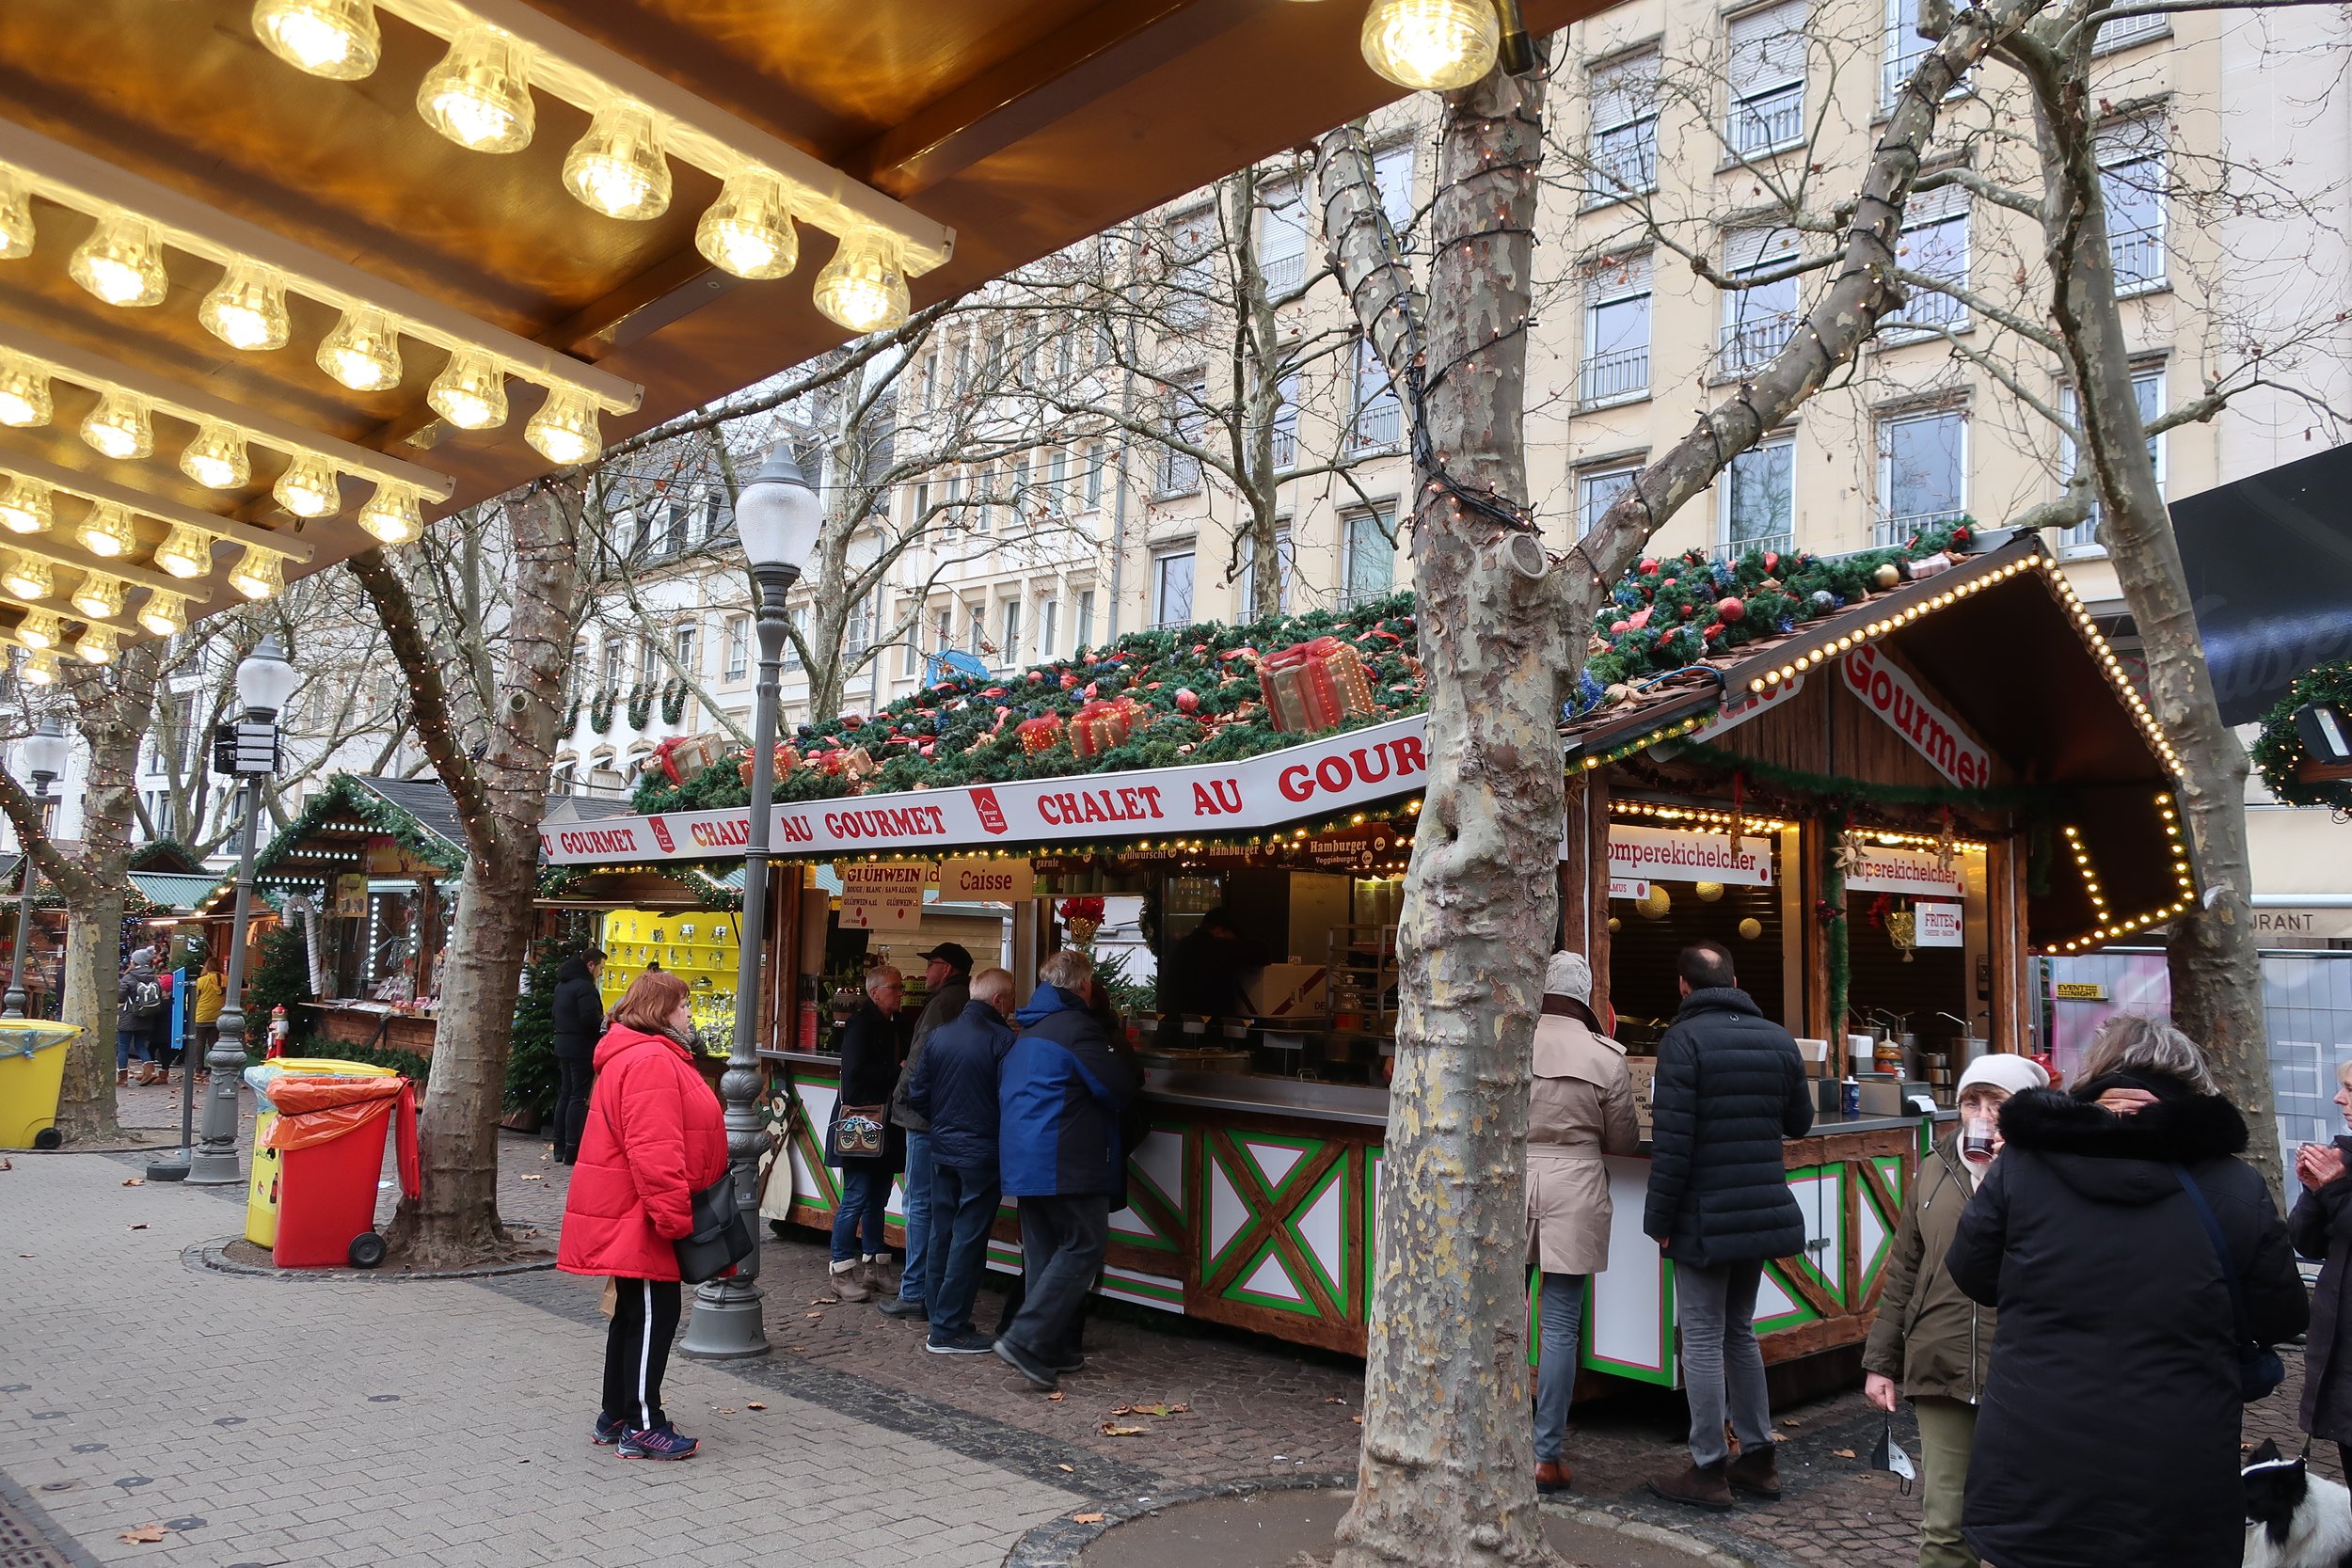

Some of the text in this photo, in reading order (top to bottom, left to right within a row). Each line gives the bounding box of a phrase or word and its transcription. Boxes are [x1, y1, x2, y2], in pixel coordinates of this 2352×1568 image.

[1845, 642, 1988, 789] Gourmet
[541, 834, 553, 856] U
[560, 829, 638, 854] GOURMET
[691, 819, 751, 847] CHALE
[781, 815, 815, 843] AU
[824, 805, 946, 839] GOURMET
[1037, 784, 1165, 826] CHALET
[1191, 778, 1244, 816] AU
[1278, 736, 1426, 802] GOUR
[1209, 844, 1259, 858] Hamburger
[1310, 839, 1367, 854] Hamburger
[1607, 840, 1756, 870] omperekichelcher
[1315, 855, 1358, 865] Veggieburger
[1860, 858, 1956, 883] perekichelcher
[847, 863, 921, 882] GLÜHWEIN
[960, 868, 1012, 891] Caisse
[1925, 913, 1955, 927] FRITES
